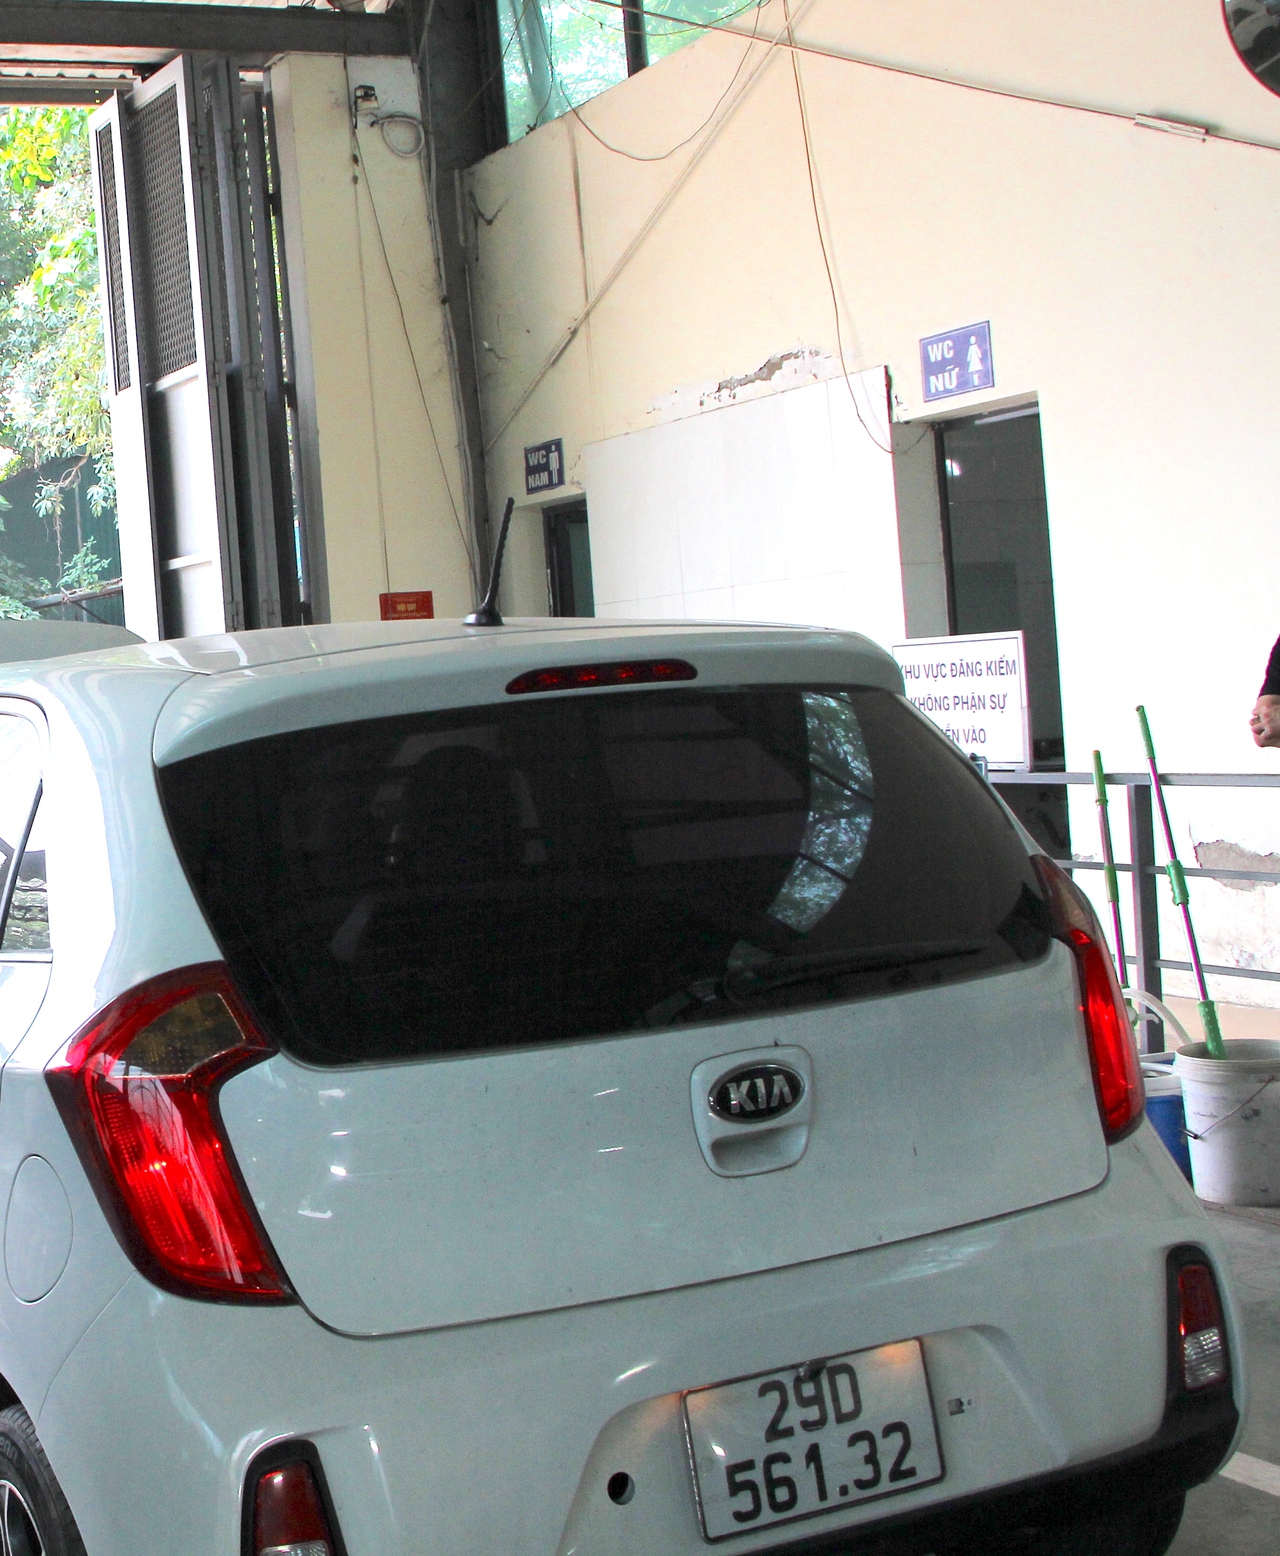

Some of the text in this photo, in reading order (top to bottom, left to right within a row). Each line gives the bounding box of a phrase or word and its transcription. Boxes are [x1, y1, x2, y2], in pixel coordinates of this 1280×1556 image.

[927, 340, 954, 363] WC
[929, 365, 960, 393] NỮ
[527, 450, 547, 467] WC
[528, 471, 549, 489] NAM
[923, 662, 948, 682] VỰC
[950, 658, 983, 678] ĐĂNG
[986, 654, 1017, 676] KIỂM
[953, 692, 986, 714] PHẬN
[989, 692, 1008, 714] SỰ
[962, 724, 986, 744] VÀO
[726, 1074, 793, 1114] KIA
[758, 1363, 862, 1443] 29D
[725, 1420, 917, 1523] 561.32
